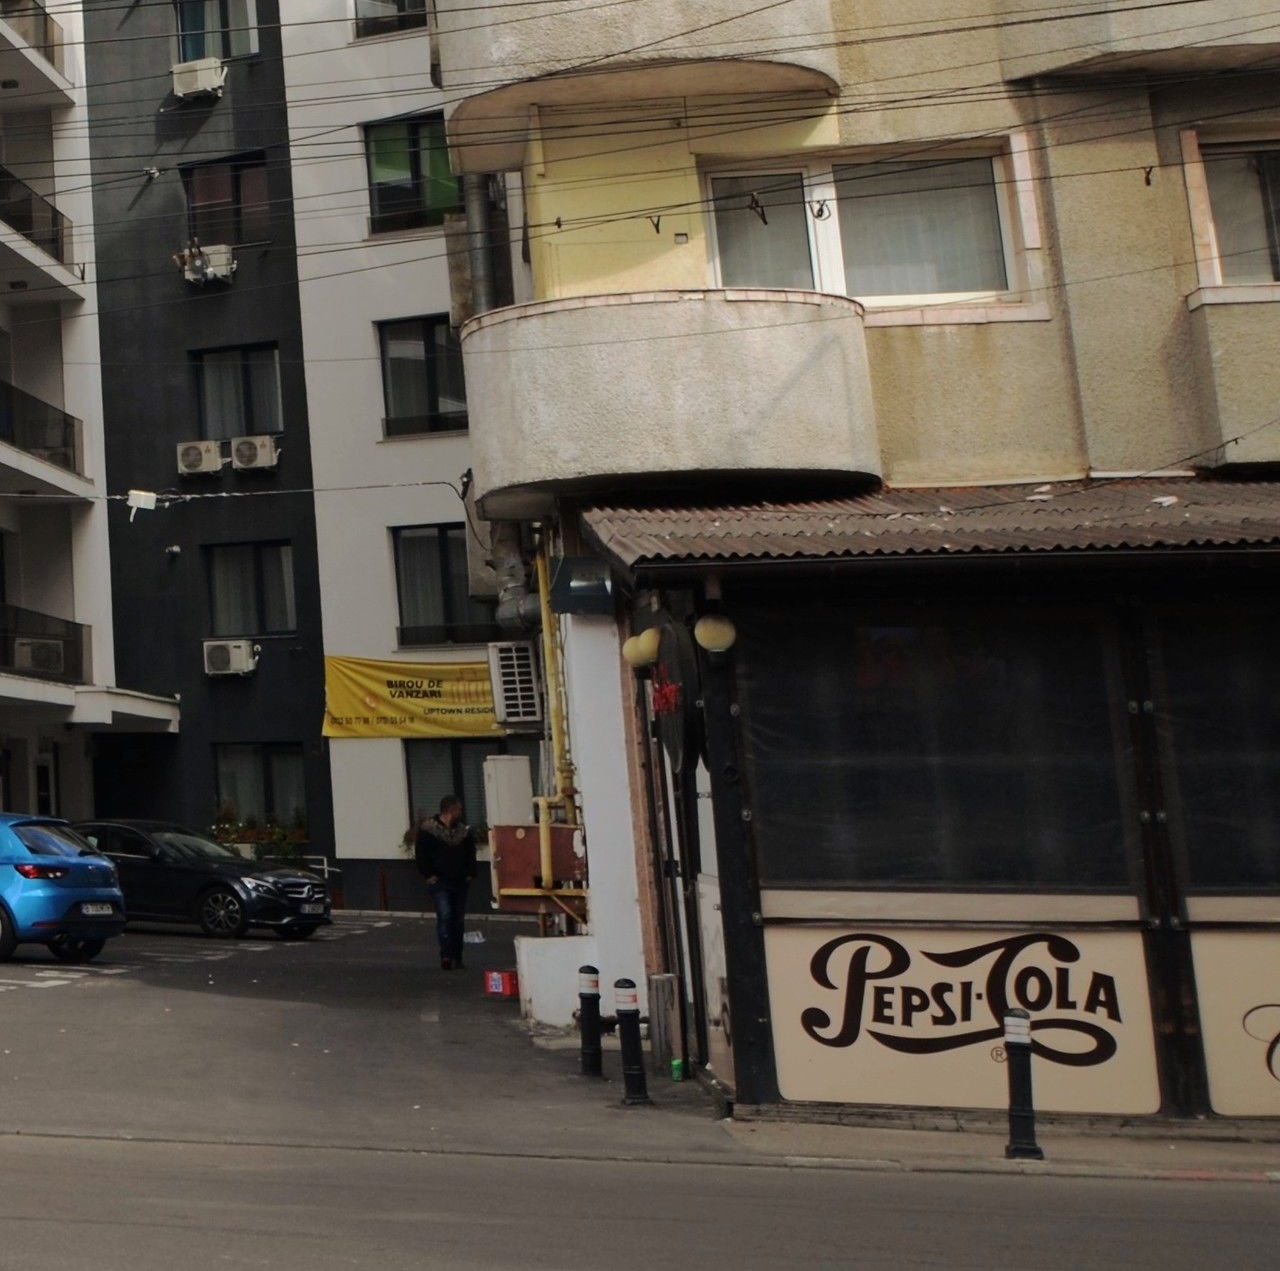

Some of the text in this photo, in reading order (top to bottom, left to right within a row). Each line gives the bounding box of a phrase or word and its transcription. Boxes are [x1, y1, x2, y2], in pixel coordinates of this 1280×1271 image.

[386, 679, 443, 689] BIROU DE
[423, 707, 463, 716] UPTOWN
